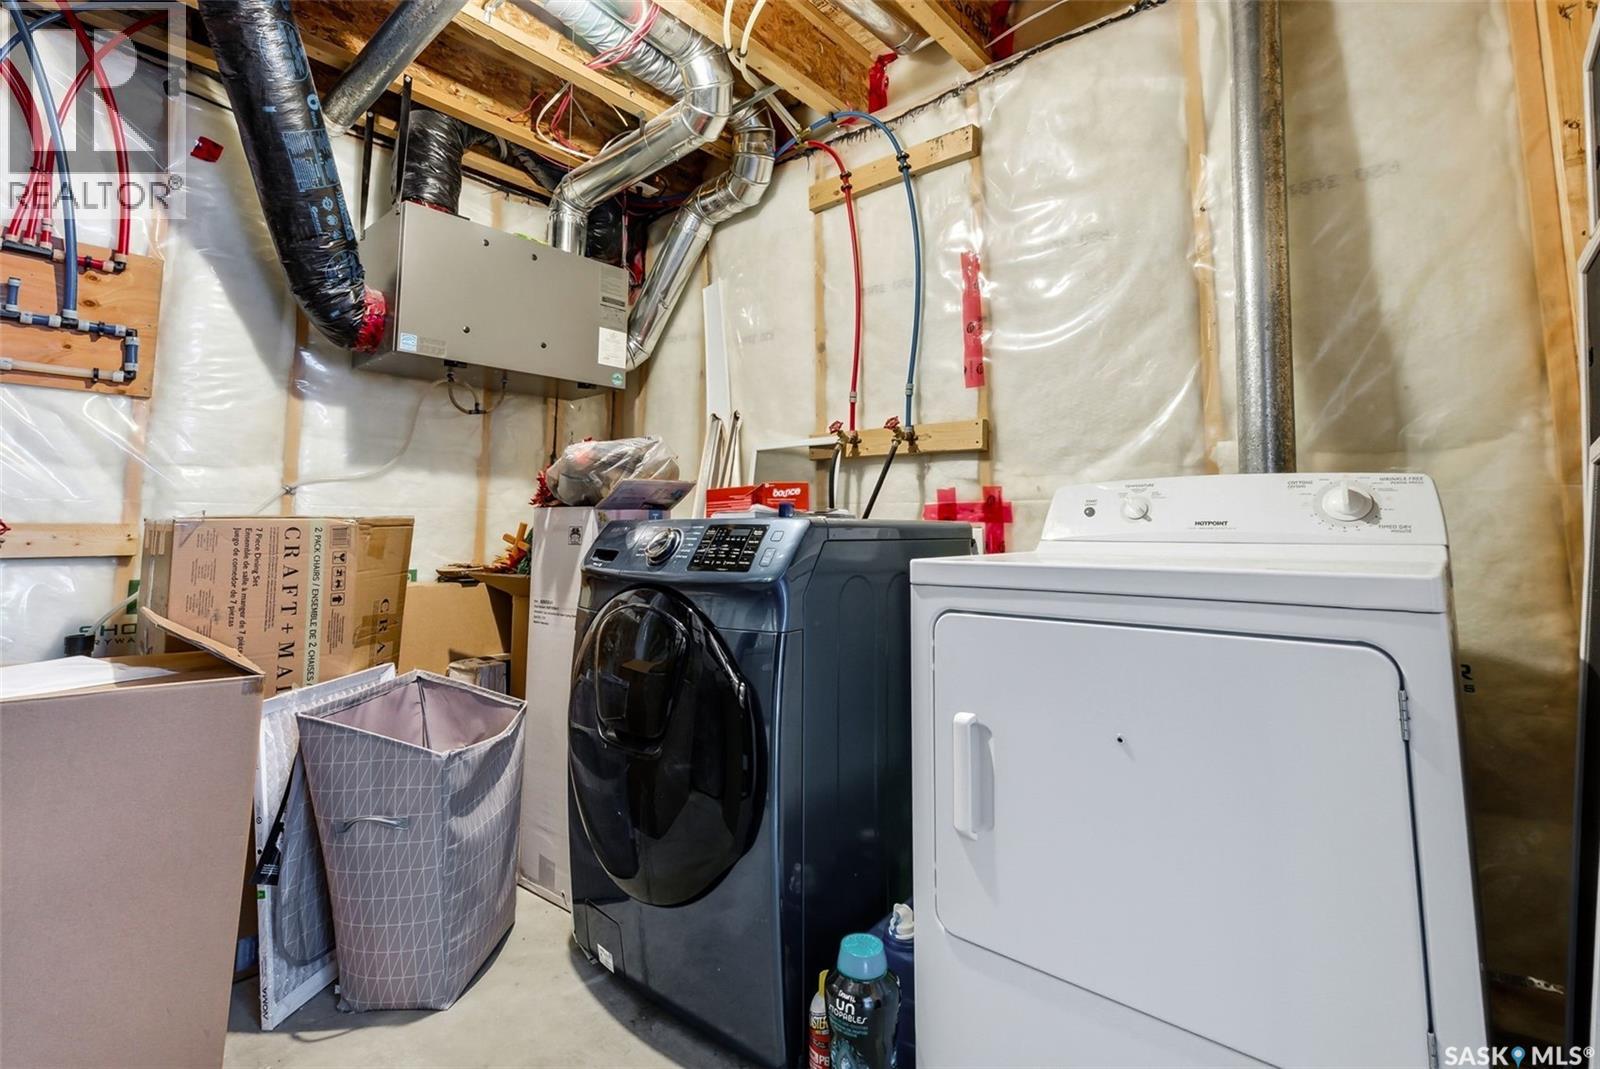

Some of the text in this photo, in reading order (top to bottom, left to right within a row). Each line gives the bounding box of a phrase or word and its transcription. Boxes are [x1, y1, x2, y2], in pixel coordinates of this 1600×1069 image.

[232, 527, 242, 547] Juego
[243, 527, 253, 560] Ensemble
[254, 533, 263, 551] Piece
[313, 534, 322, 553] PACK
[232, 548, 240, 557] de
[230, 557, 239, 588] comedor
[242, 560, 250, 570] de
[251, 552, 262, 574] Dining
[281, 526, 301, 615] CRAFT
[312, 554, 321, 582] CHAIRS
[241, 571, 250, 586] salle
[252, 575, 261, 587] Set
[230, 589, 238, 599] de
[238, 593, 247, 618] manger
[309, 588, 320, 627] ENSEMBLE
[239, 620, 247, 629] de
[308, 629, 317, 640] DE
[306, 649, 316, 682] CHAISES
